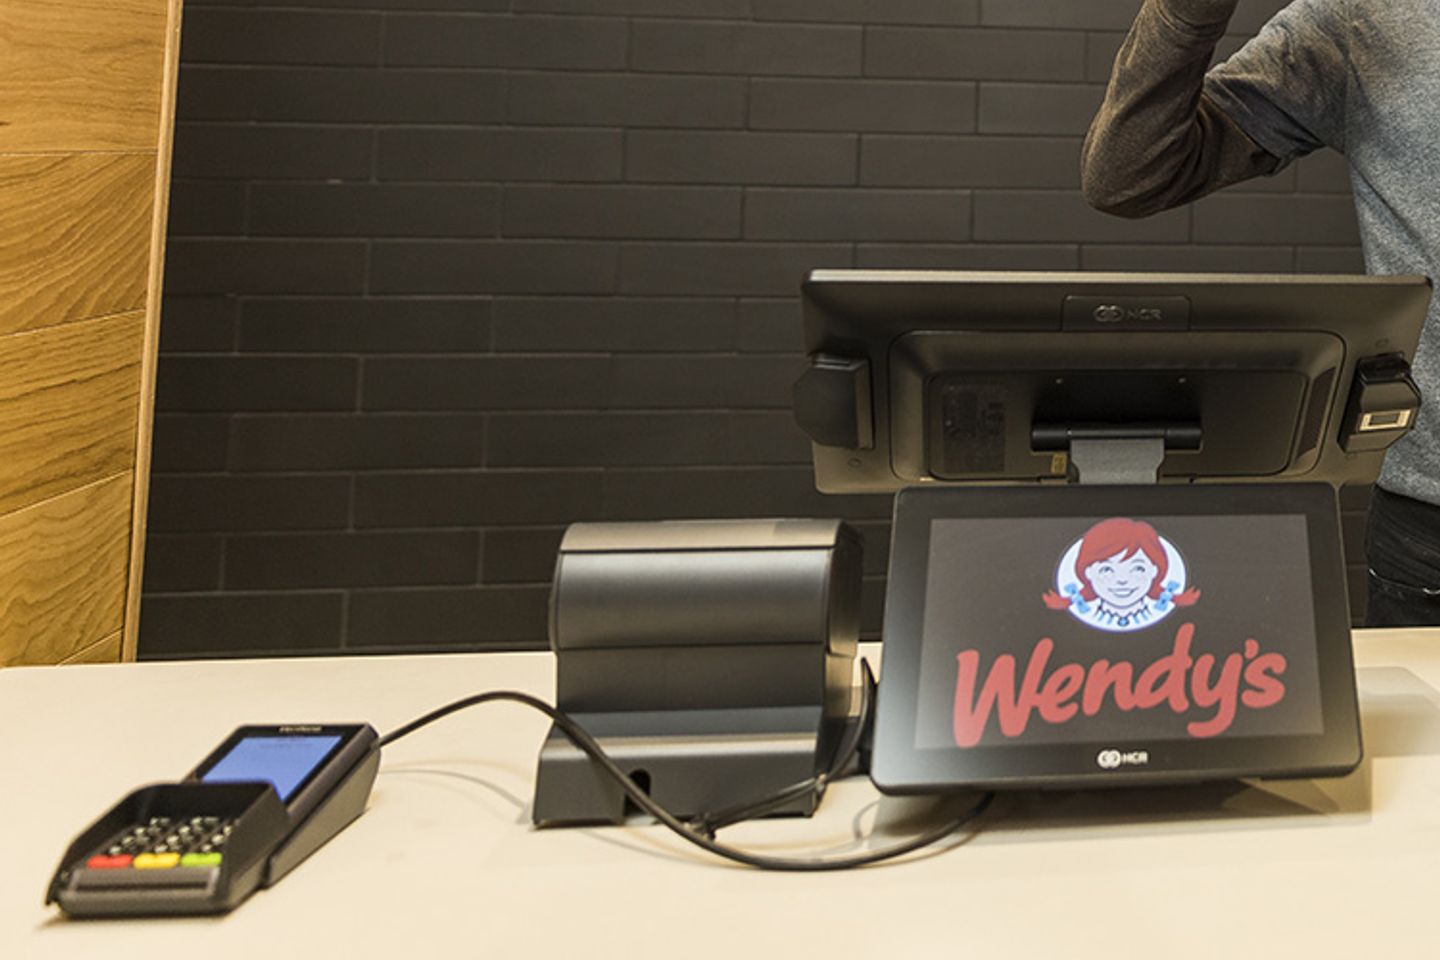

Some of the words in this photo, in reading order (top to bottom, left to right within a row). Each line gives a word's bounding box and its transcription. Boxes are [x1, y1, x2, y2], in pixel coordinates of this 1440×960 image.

[1127, 307, 1162, 321] NCR
[953, 623, 1287, 749] Wendy's
[1122, 751, 1148, 764] NCR
